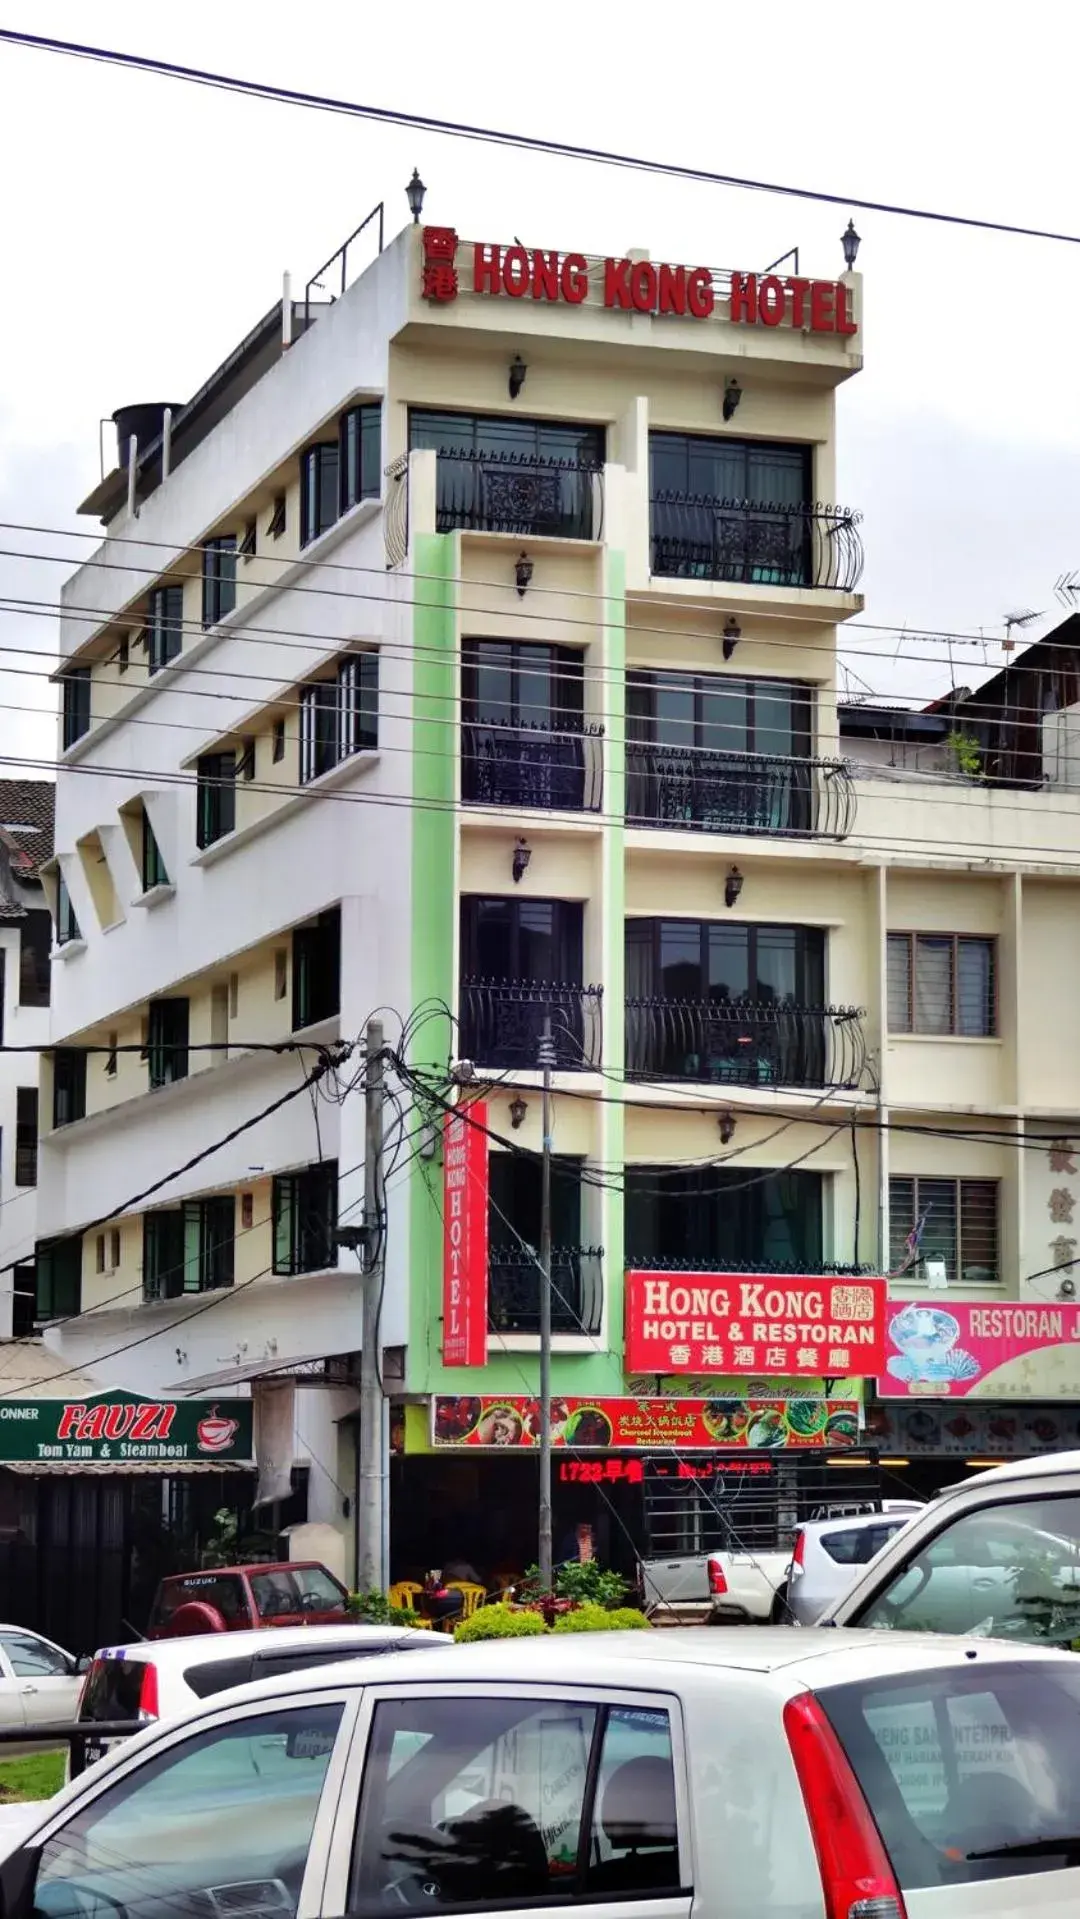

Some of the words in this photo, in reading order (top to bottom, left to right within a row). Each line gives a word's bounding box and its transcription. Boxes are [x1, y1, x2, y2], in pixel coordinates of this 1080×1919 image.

[422, 226, 459, 301] 香港
[473, 243, 588, 304] HONG
[604, 257, 714, 319] KONG
[730, 271, 858, 335] HOTEL
[450, 1190, 463, 1335] HOTEL
[643, 1281, 730, 1317] HONG
[738, 1282, 825, 1319] KONG
[643, 1320, 719, 1341] HOTEL
[728, 1323, 744, 1341] &
[753, 1324, 874, 1345] RESTORAN
[969, 1309, 1062, 1338] RESTORAN
[57, 1404, 177, 1440] FAUZI
[38, 1443, 63, 1457] Tom
[66, 1443, 92, 1457] Yam
[100, 1444, 111, 1457] &
[120, 1443, 188, 1457] Steamboat
[183, 1576, 217, 1586] SUZUKI
